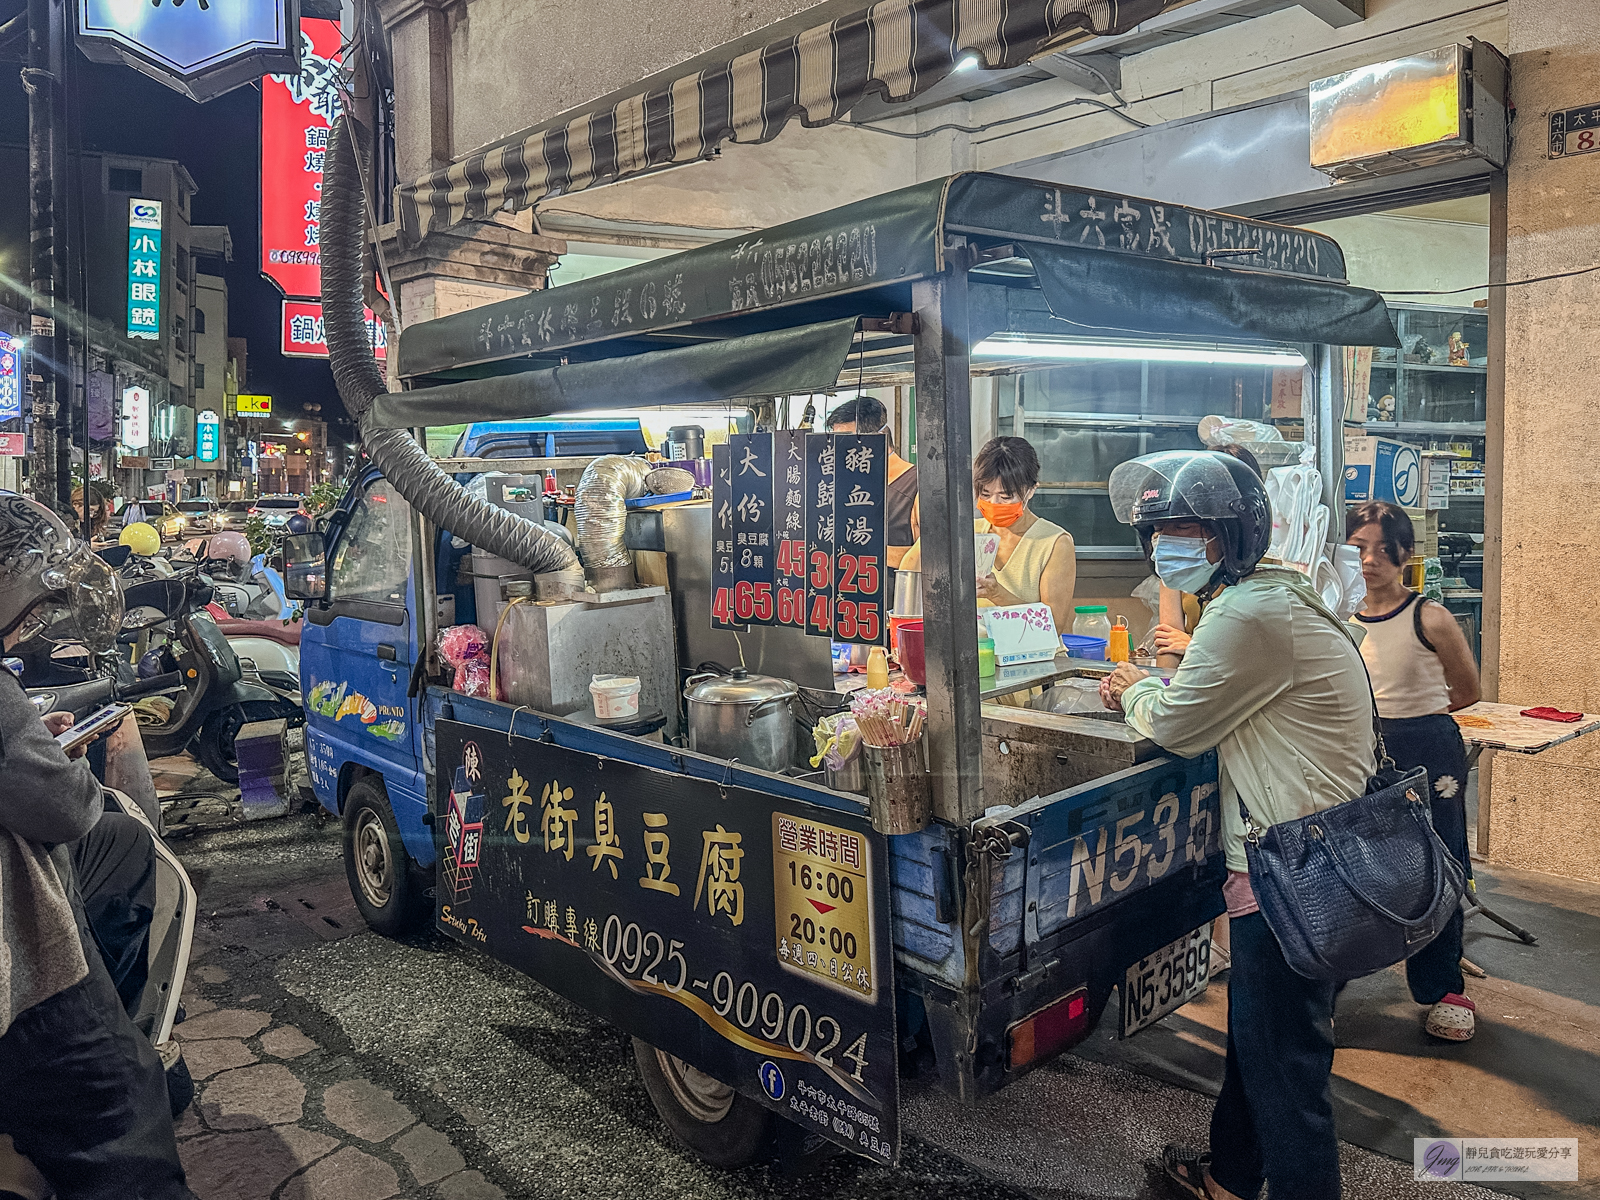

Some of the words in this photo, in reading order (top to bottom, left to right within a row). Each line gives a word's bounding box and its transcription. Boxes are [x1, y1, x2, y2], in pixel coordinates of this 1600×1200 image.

[1551, 116, 1564, 153] 斗六市
[1573, 109, 1600, 127] 太平
[1577, 130, 1600, 150] 8
[132, 235, 158, 326] 小林眼鏡
[737, 446, 767, 523] 大份
[785, 442, 803, 531] 大腸麵線
[843, 446, 875, 545] 豬血湯
[737, 532, 769, 546] 臭豆腐
[719, 557, 733, 574] 5
[740, 548, 764, 569] 8顆
[776, 540, 805, 577] 45
[810, 551, 834, 589] 3
[838, 554, 880, 594] 25
[735, 581, 774, 620] 65
[777, 587, 805, 625] 60
[810, 595, 834, 633] 4
[837, 600, 880, 640] 35
[502, 767, 745, 927] 老街臭豆腐
[778, 817, 861, 869] 營業時間
[789, 861, 855, 903] 16:00
[441, 905, 468, 934] Stinky
[467, 918, 487, 943] Tofu
[790, 913, 857, 960] 20:00
[525, 889, 602, 952] 訂購專線
[602, 914, 871, 1083] 0925-909024
[859, 1130, 891, 1160] 臭豆腐
